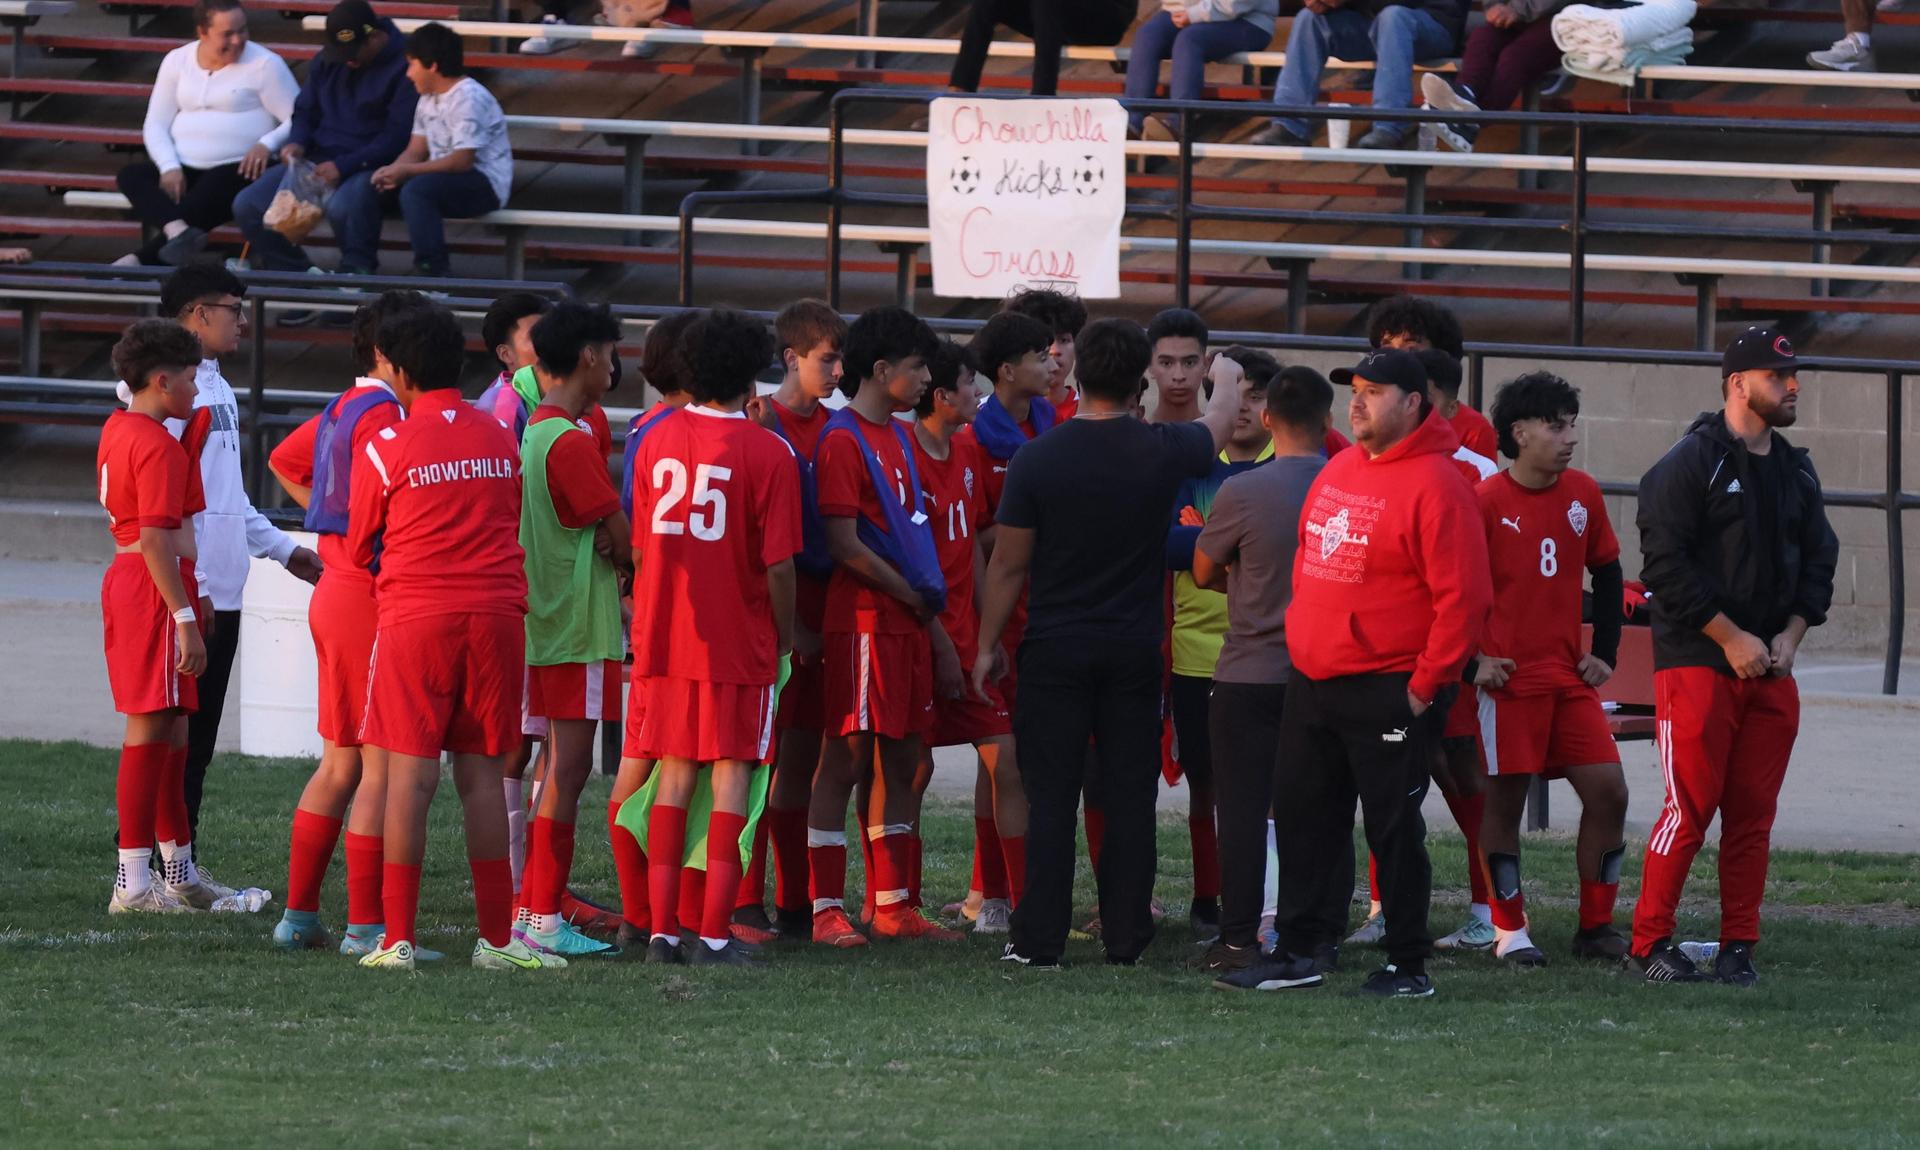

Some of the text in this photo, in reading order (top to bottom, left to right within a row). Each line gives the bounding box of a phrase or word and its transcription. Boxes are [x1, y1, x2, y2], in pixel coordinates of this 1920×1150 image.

[952, 105, 1110, 145] Chowchilla
[994, 157, 1068, 200] Kicks
[960, 206, 1080, 279] Grass
[407, 457, 513, 489] CHOWCHILLA
[651, 457, 733, 542] 25
[947, 498, 969, 542] 11
[1539, 537, 1558, 578] 8
